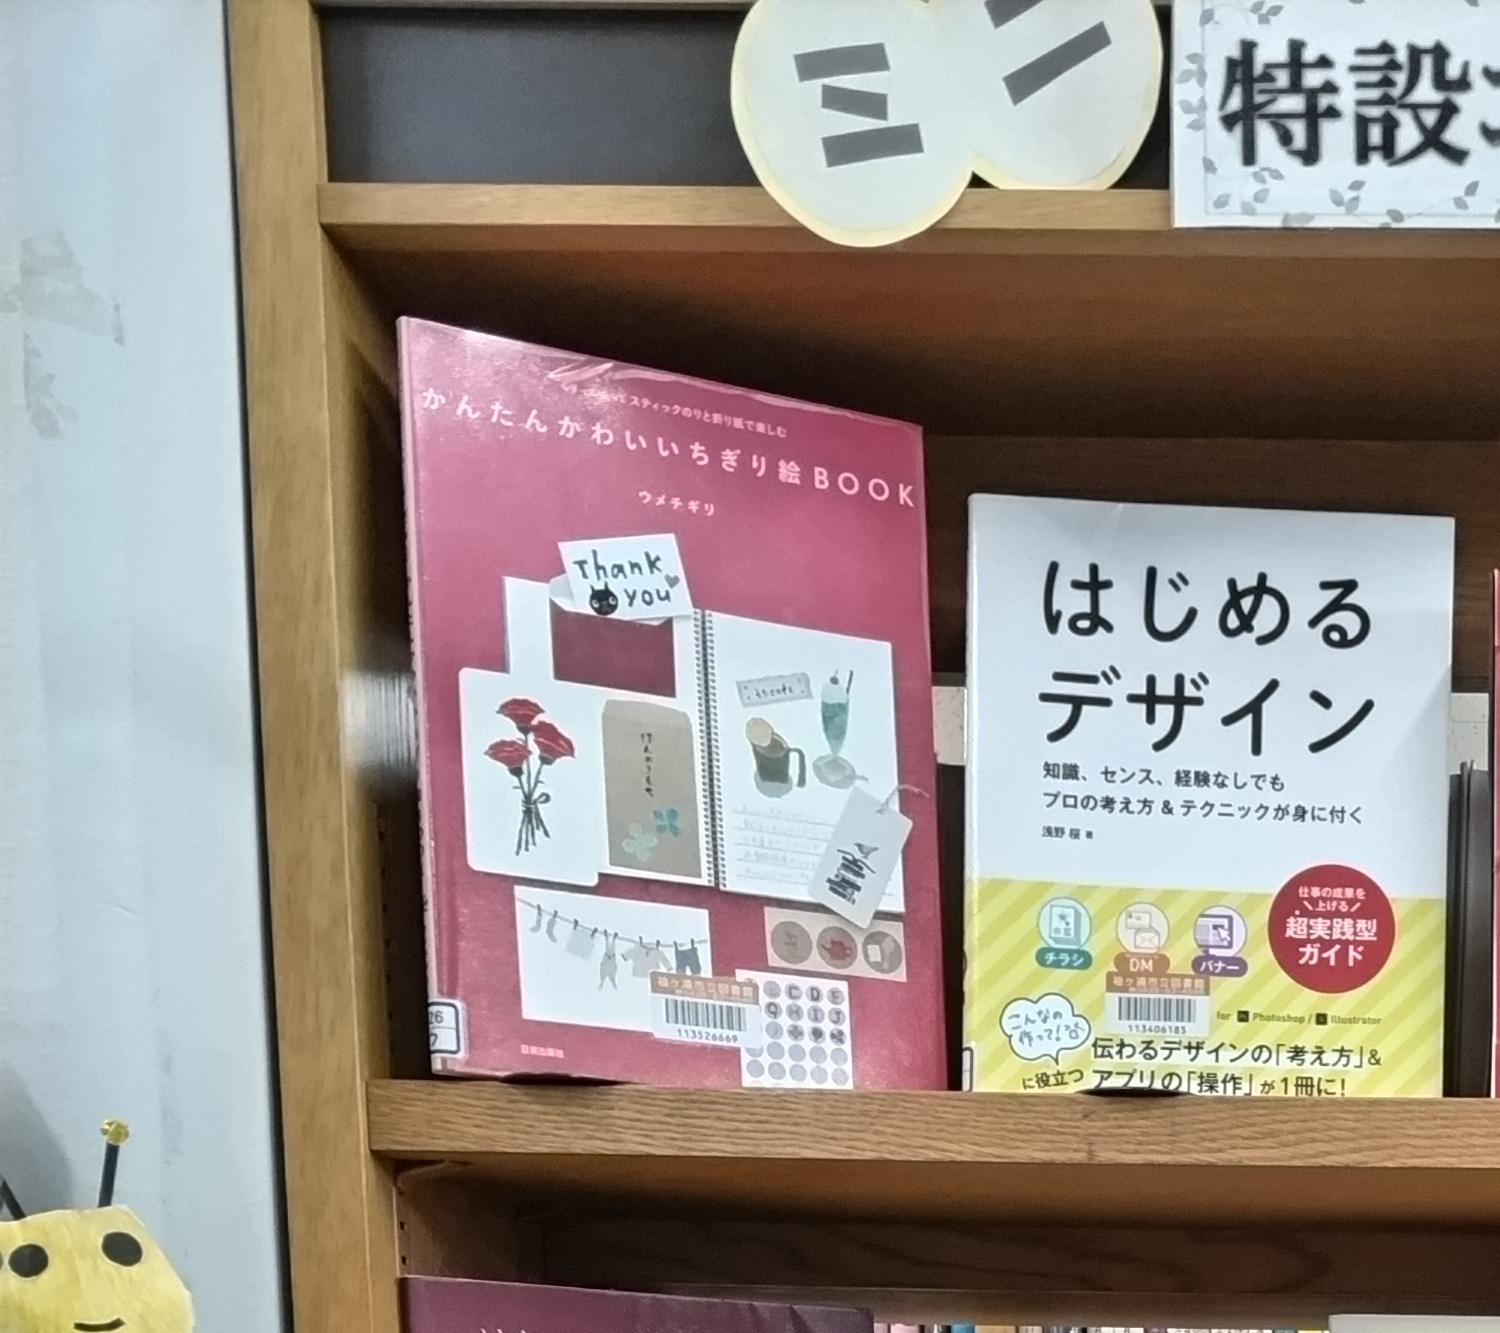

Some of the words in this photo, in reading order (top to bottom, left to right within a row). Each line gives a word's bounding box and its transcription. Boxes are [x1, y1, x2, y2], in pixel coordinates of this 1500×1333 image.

[637, 490, 716, 518] ウメチギリ
[572, 548, 663, 585] Thank
[624, 586, 673, 610] you
[1043, 560, 1372, 649] はじめる
[1038, 665, 1375, 757] デザイン
[1042, 761, 1286, 793] 知識、センス、経験なしでも
[1297, 885, 1367, 900] 仕事の成果を
[1284, 915, 1378, 941] 超実践型
[1043, 950, 1086, 967] チラシ
[1128, 955, 1155, 974] DM
[1199, 958, 1240, 974] バナー
[1297, 943, 1367, 967] ガイド
[676, 1028, 739, 1045] 113526669
[1022, 1071, 1085, 1090] に役立つ
